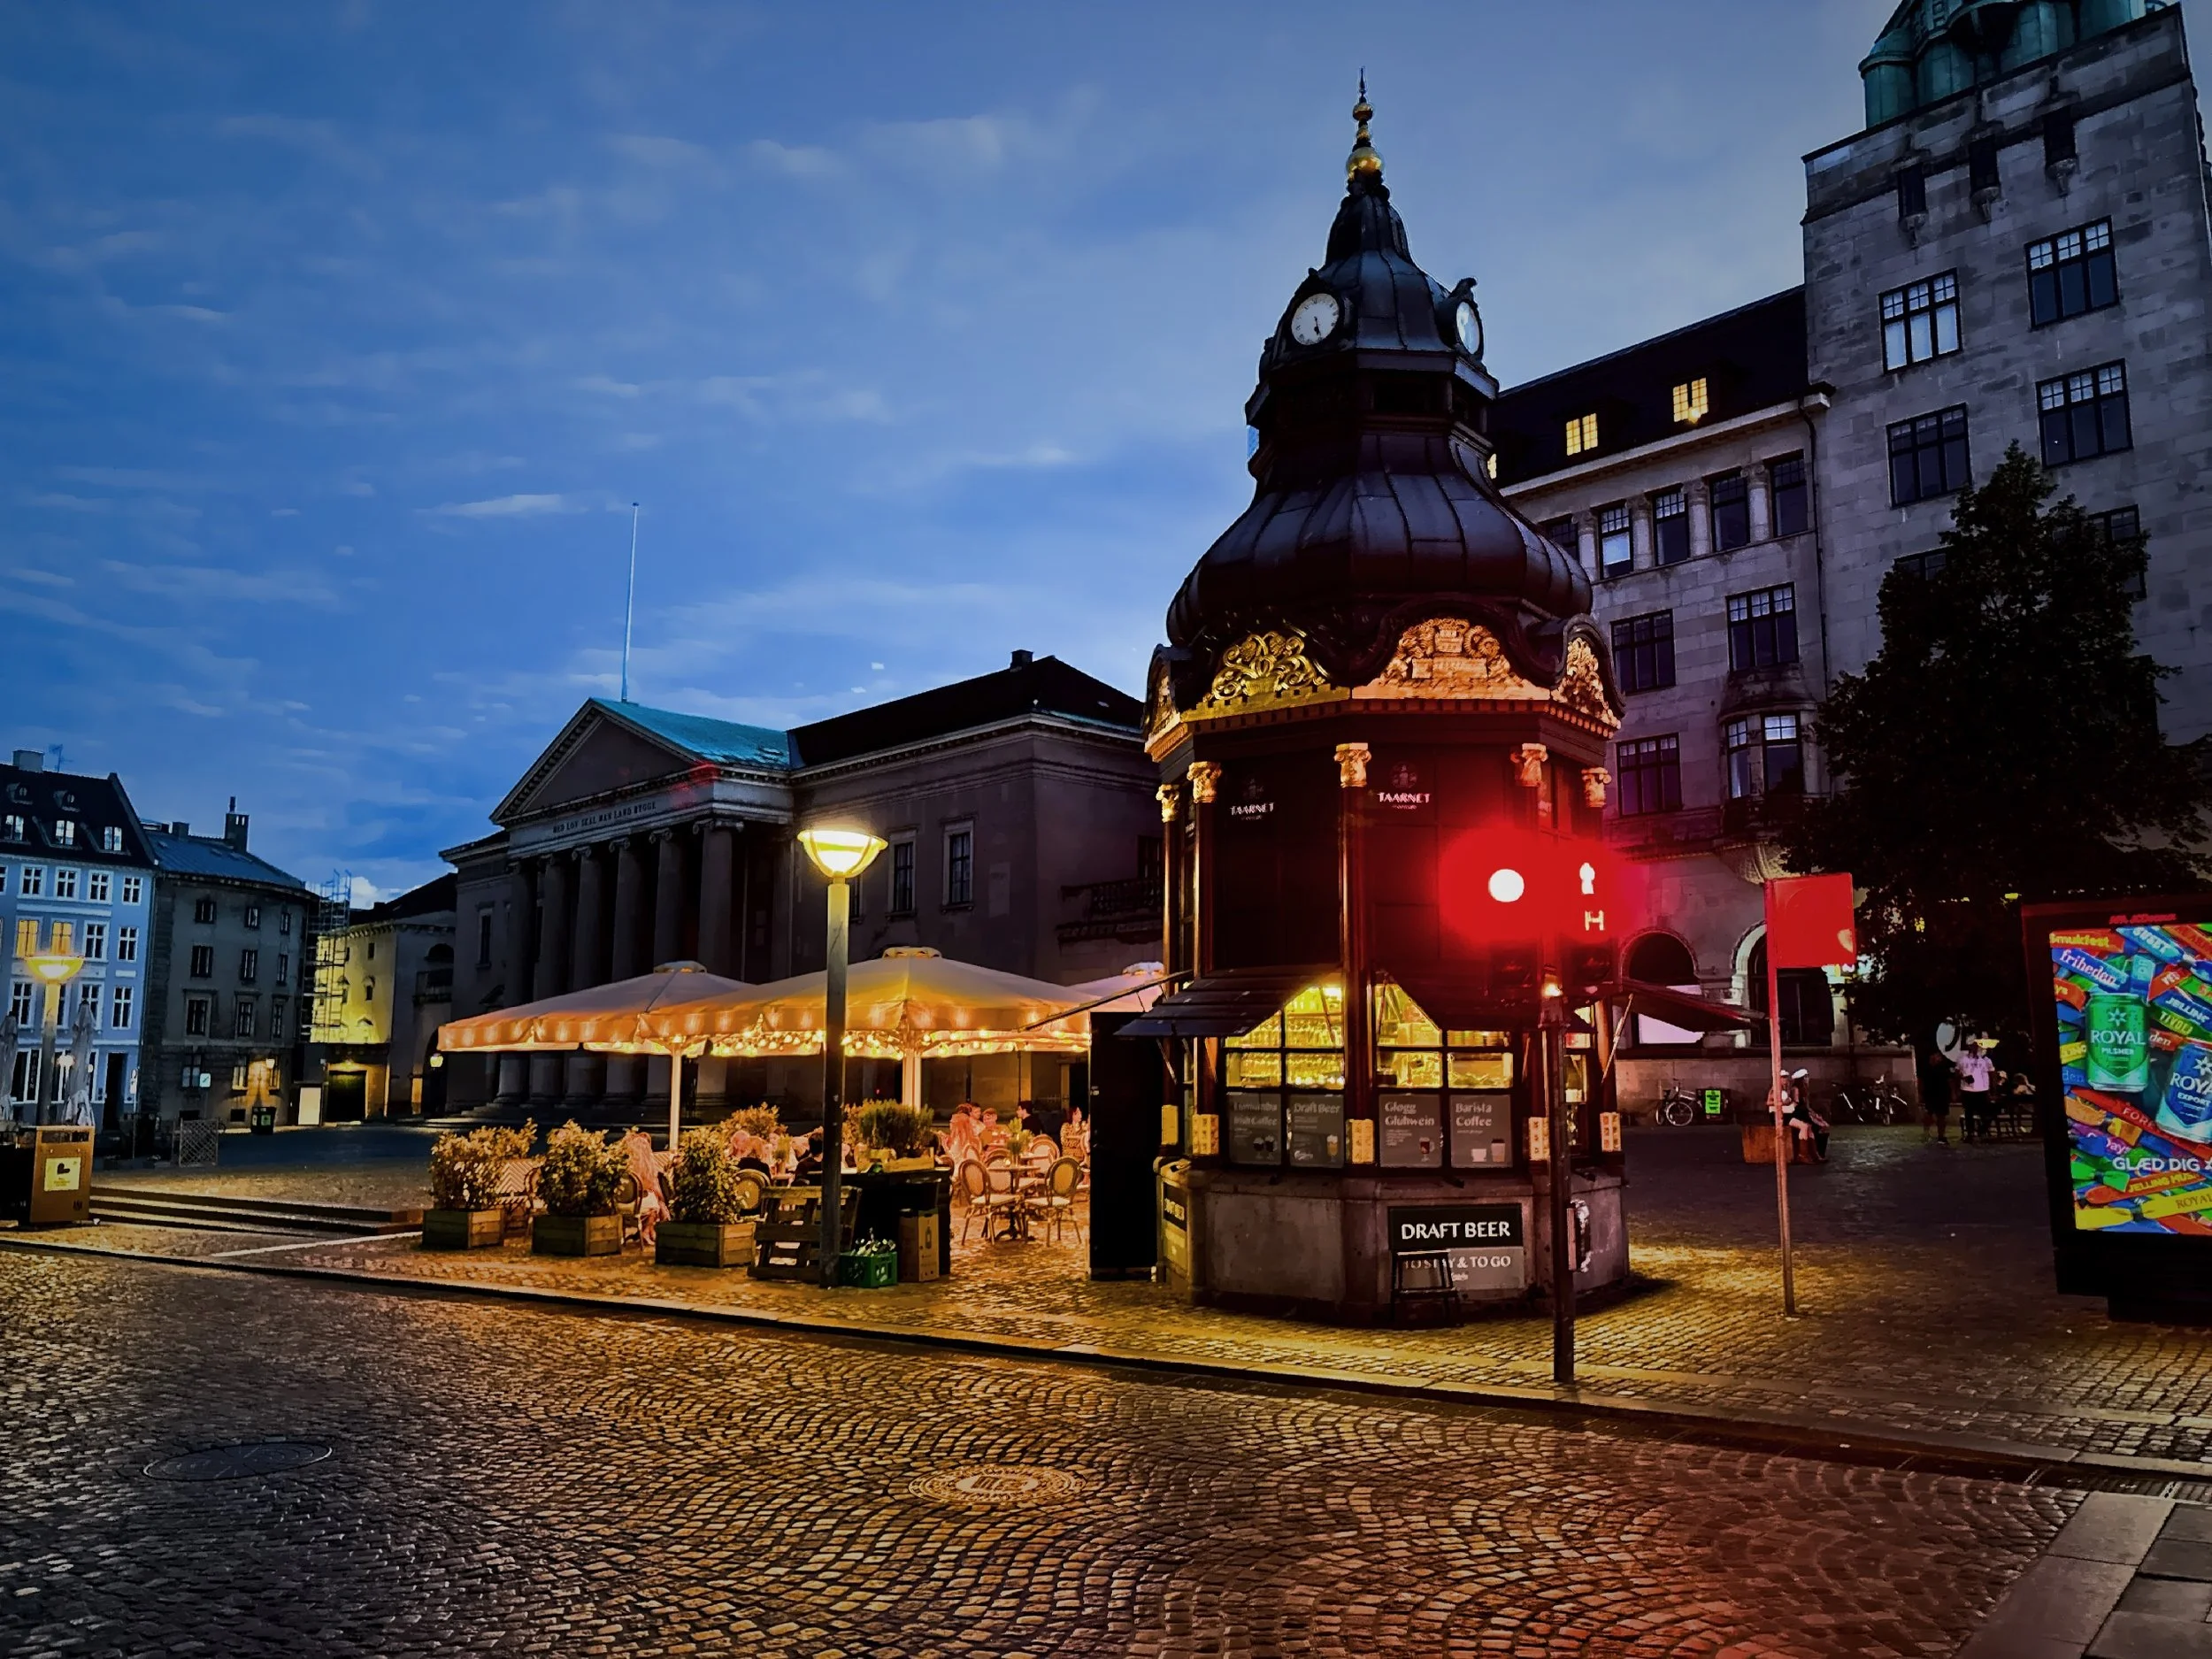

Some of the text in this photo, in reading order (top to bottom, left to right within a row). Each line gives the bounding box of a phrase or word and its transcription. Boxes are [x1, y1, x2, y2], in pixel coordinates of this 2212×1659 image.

[1377, 792, 1430, 803] TAARNET
[2090, 1030, 2147, 1045] ROYAL
[2177, 1092, 2211, 1107] EXPORT
[1294, 1102, 1341, 1113] Draft Beer
[1455, 1102, 1493, 1113] Barista
[1455, 1117, 1492, 1126] Coffee
[2113, 1157, 2200, 1171] GLÆD DIG
[2129, 1175, 2170, 1193] JELLING
[1401, 1221, 1510, 1240] DRAFT BEER
[1457, 1256, 1469, 1268] &
[1470, 1256, 1488, 1268] TO
[1490, 1256, 1511, 1267] GO
